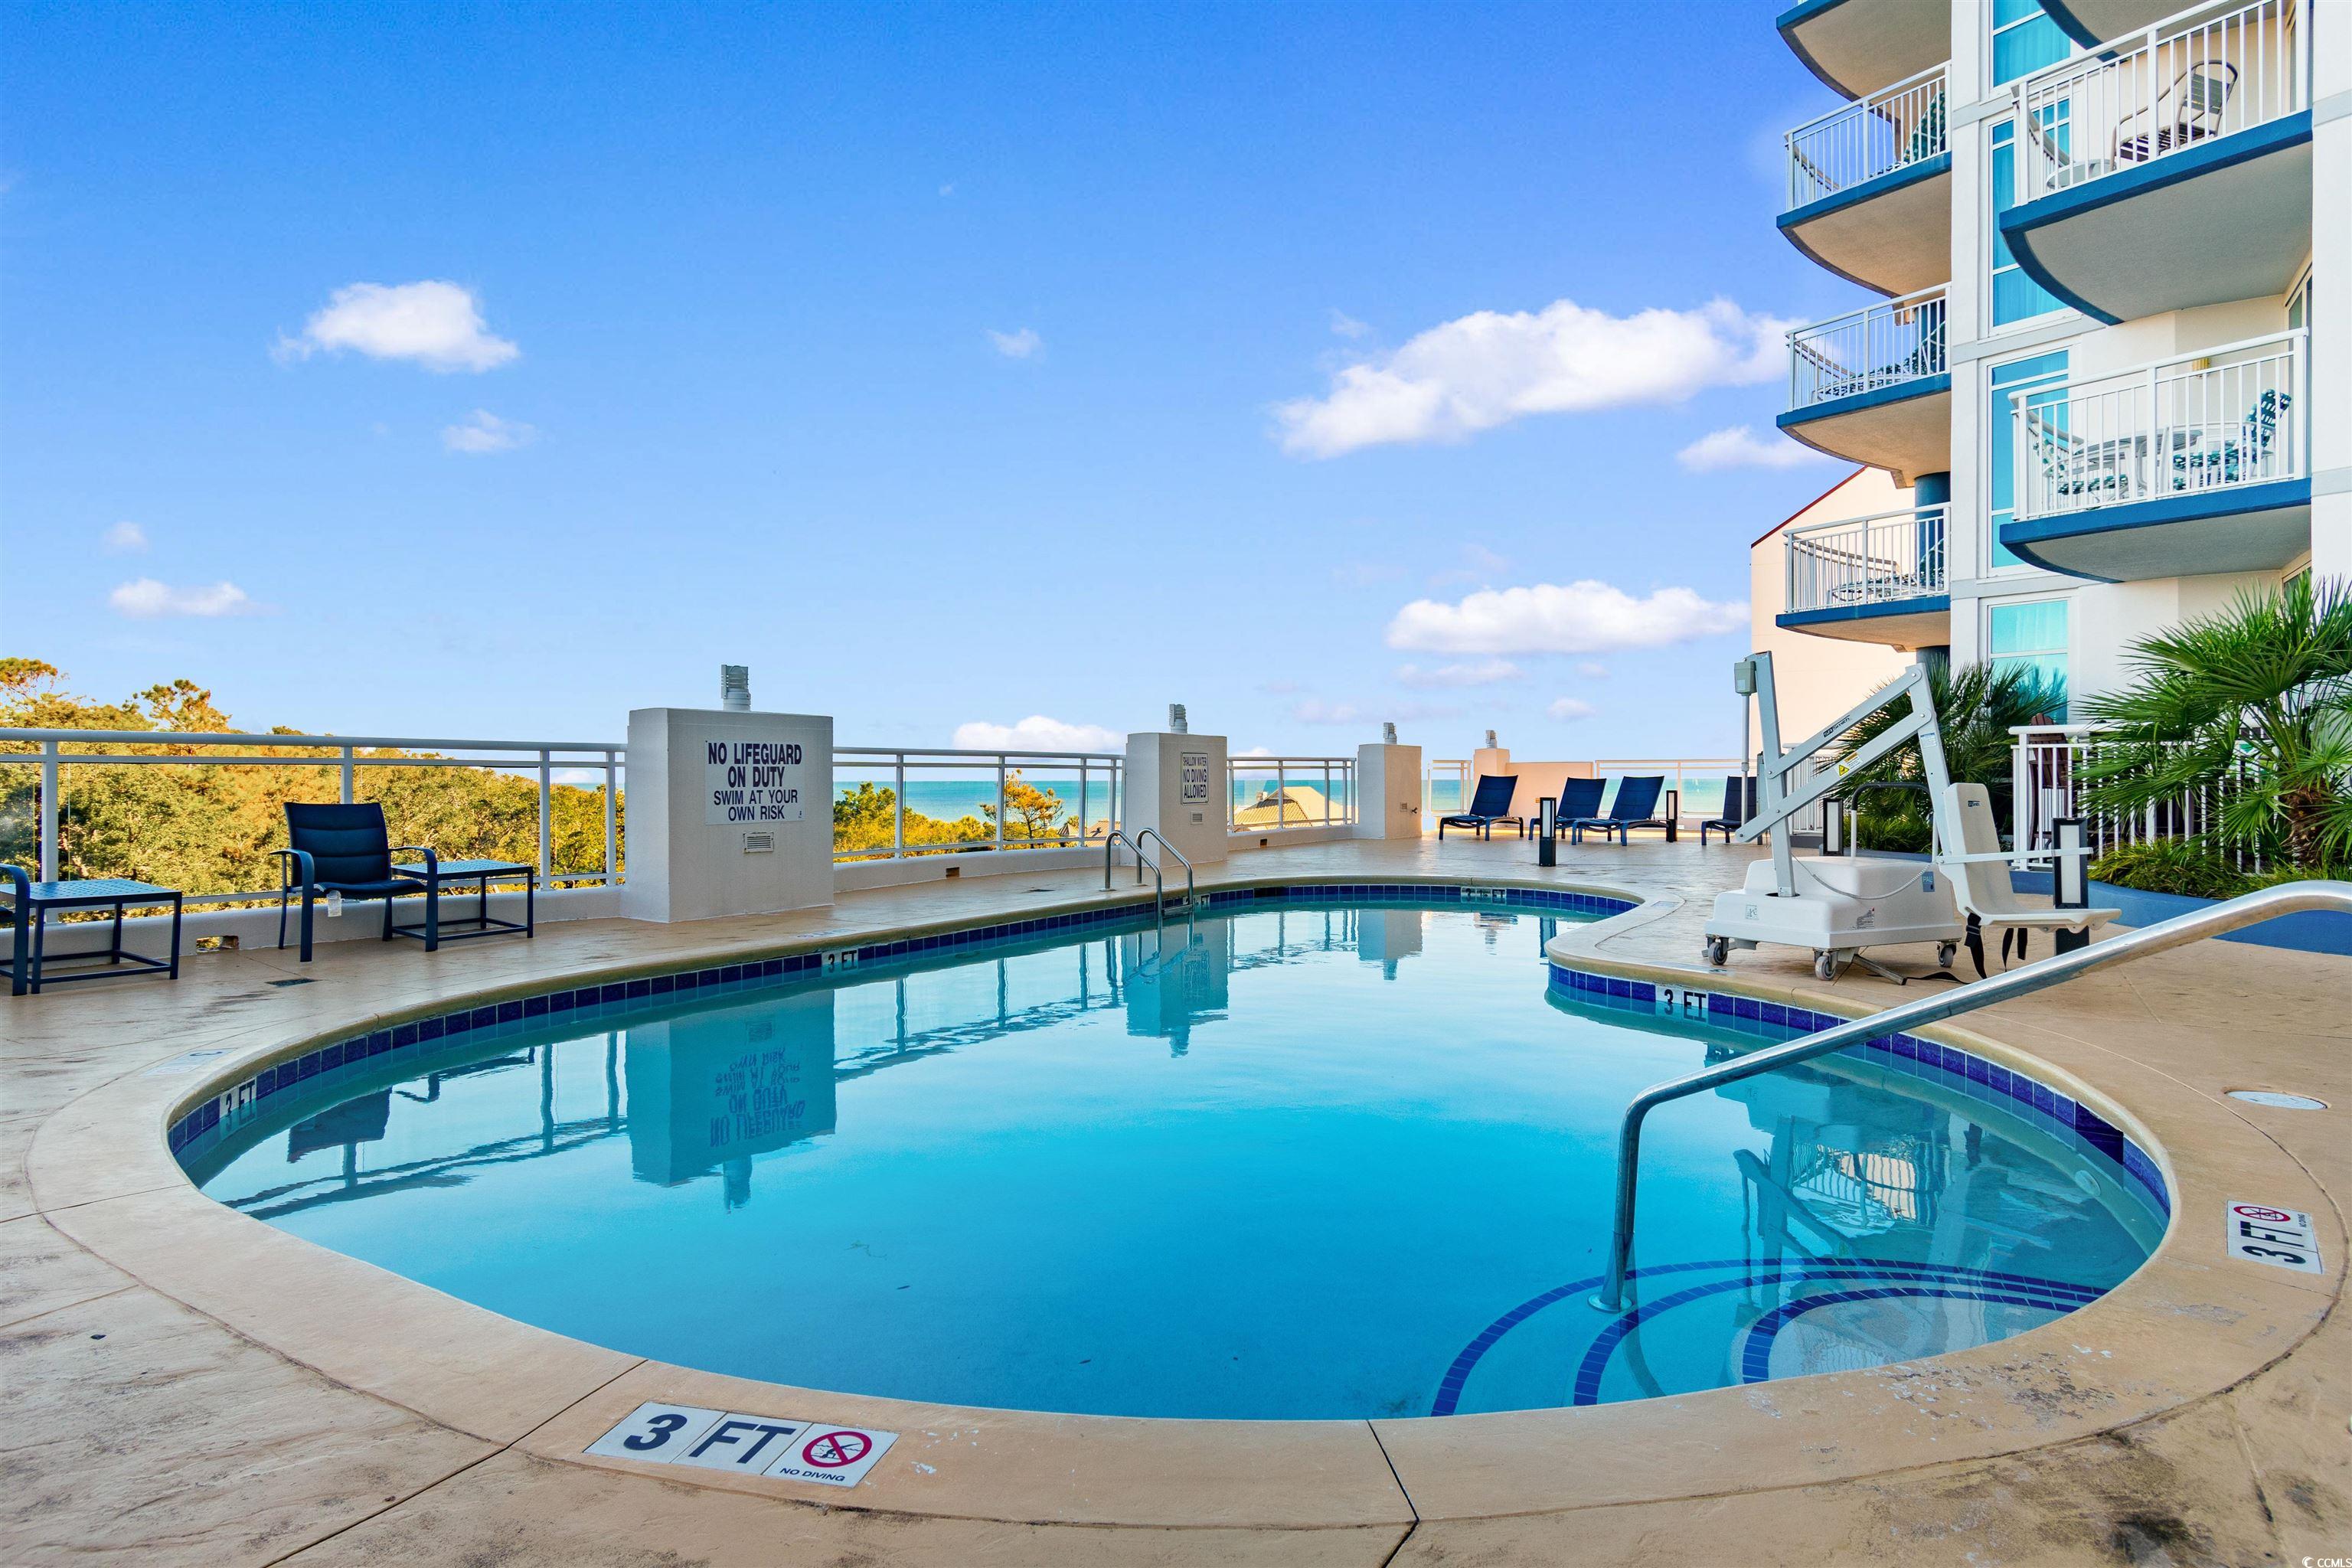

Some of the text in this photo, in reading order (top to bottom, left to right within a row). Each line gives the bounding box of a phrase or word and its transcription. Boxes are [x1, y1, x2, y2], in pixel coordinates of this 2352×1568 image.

[708, 743, 802, 765] NO LIFEGUARD
[727, 766, 785, 788] ON DUTY
[1183, 769, 1207, 782] NO DIVING
[714, 789, 798, 805] SWIM AT YOUR
[1184, 784, 1207, 798] ALLOWED
[728, 806, 755, 821] OWN
[760, 805, 785, 820] RISK
[841, 950, 858, 964] FT
[1684, 990, 1707, 1009] FT
[239, 1080, 255, 1110] FT
[2239, 1220, 2306, 1264] 3 FT
[623, 1413, 796, 1464] 3 FT
[802, 1471, 845, 1481] DIVING
